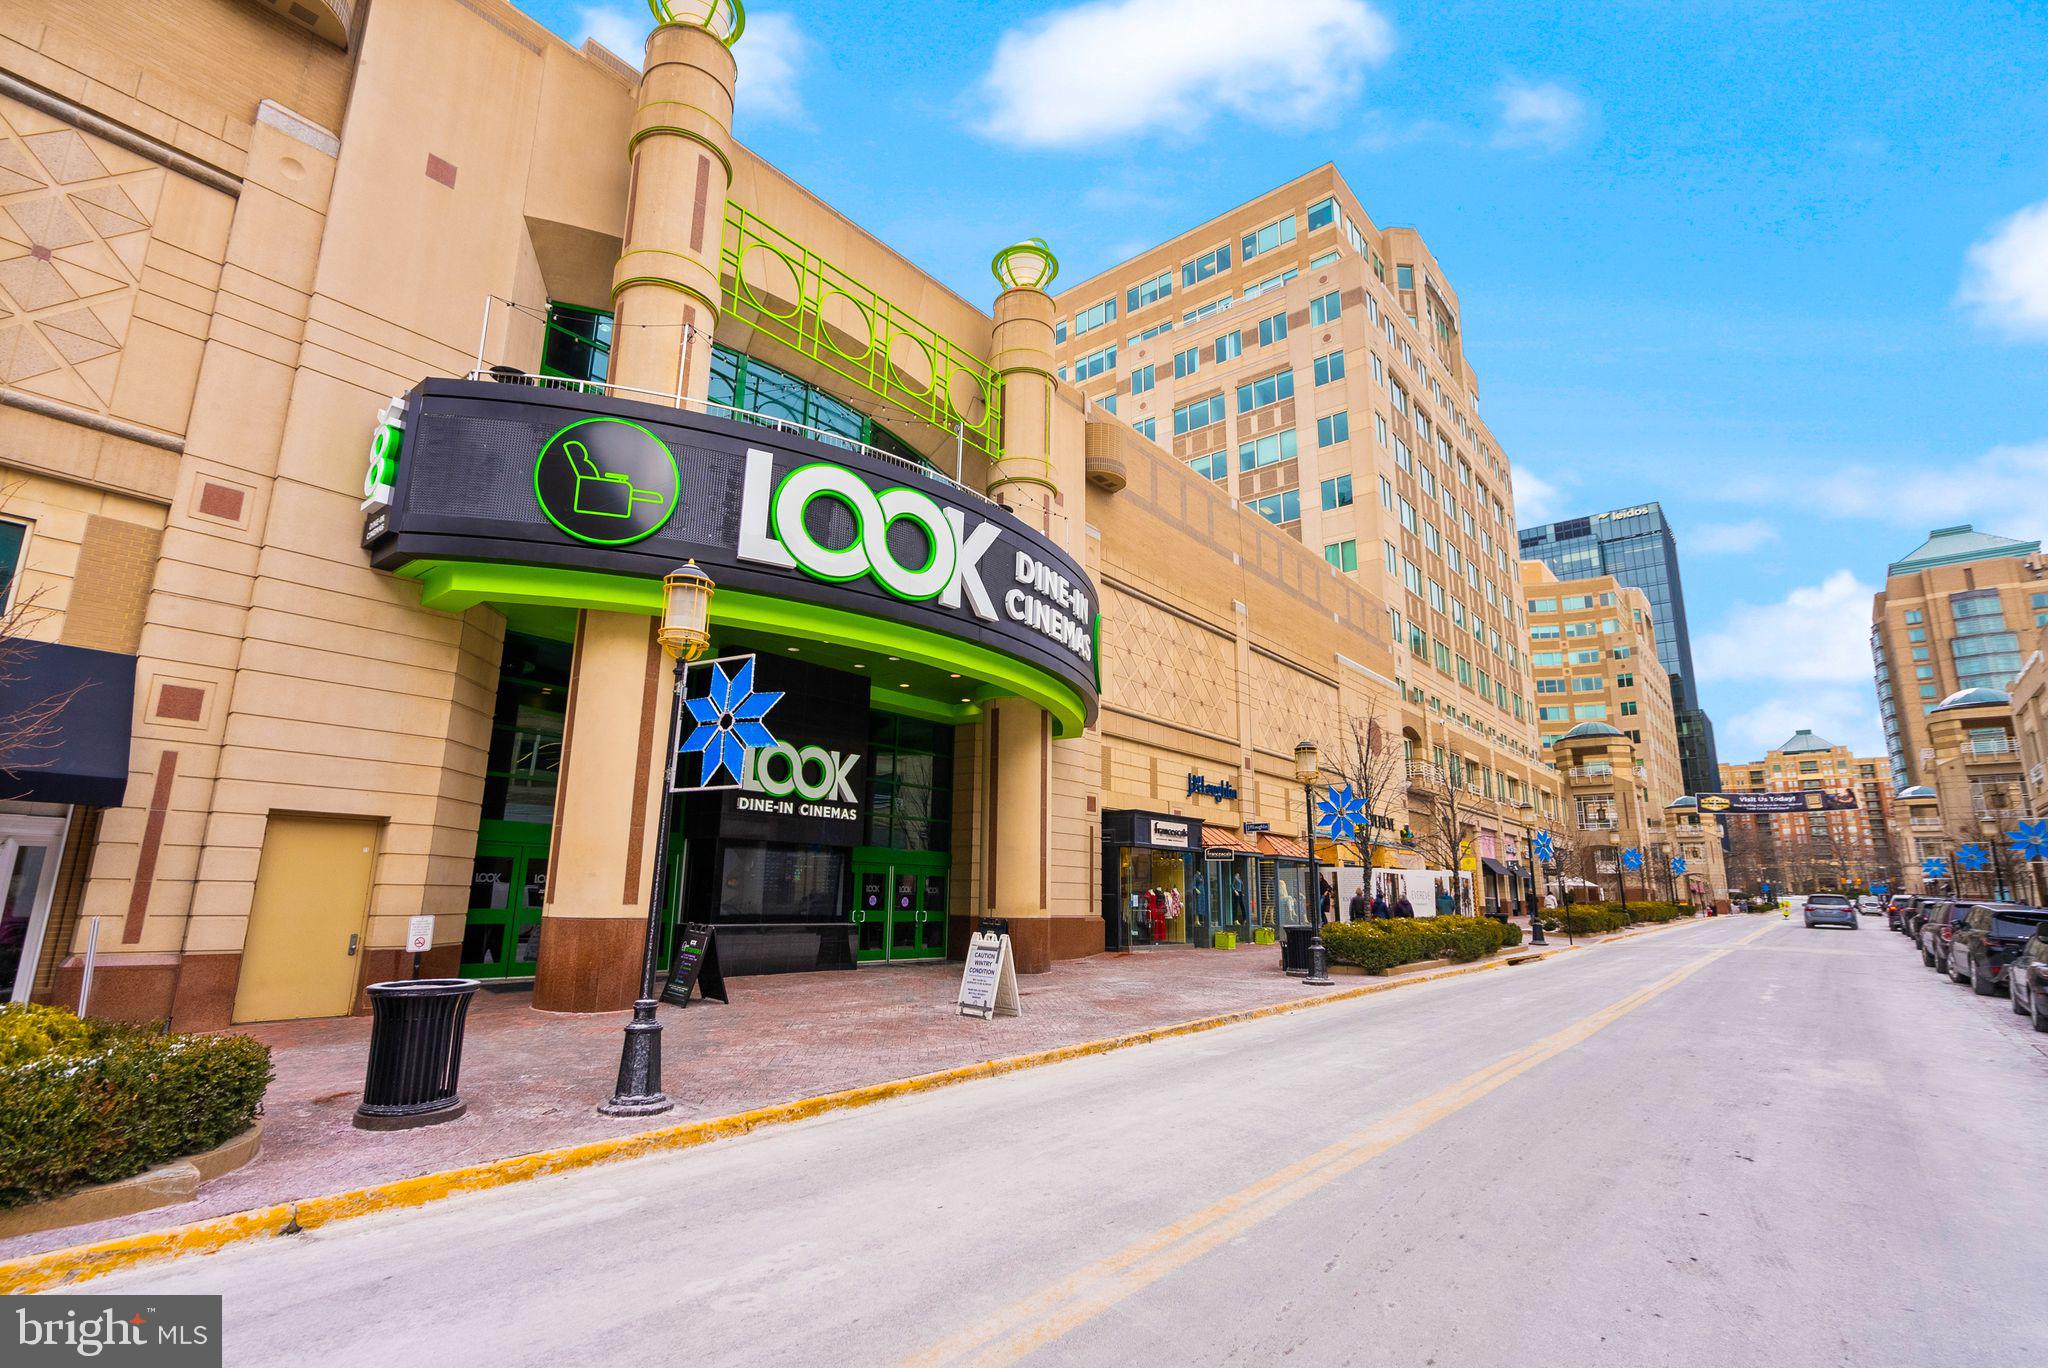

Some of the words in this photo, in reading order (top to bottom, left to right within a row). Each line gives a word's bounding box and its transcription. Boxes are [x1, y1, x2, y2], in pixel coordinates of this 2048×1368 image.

[1612, 506, 1649, 521] leidos
[737, 448, 1002, 622] LOOK
[1014, 550, 1089, 625] DINE-IN
[1005, 588, 1091, 662] CINEMAS
[743, 741, 860, 803] LOOK
[737, 797, 793, 814] DINE-IN
[799, 804, 857, 820] CINEMAS
[475, 873, 501, 883] LOOK
[974, 952, 996, 960] CAUTION
[974, 959, 993, 967] WINTRY
[969, 967, 995, 976] CONDITION
